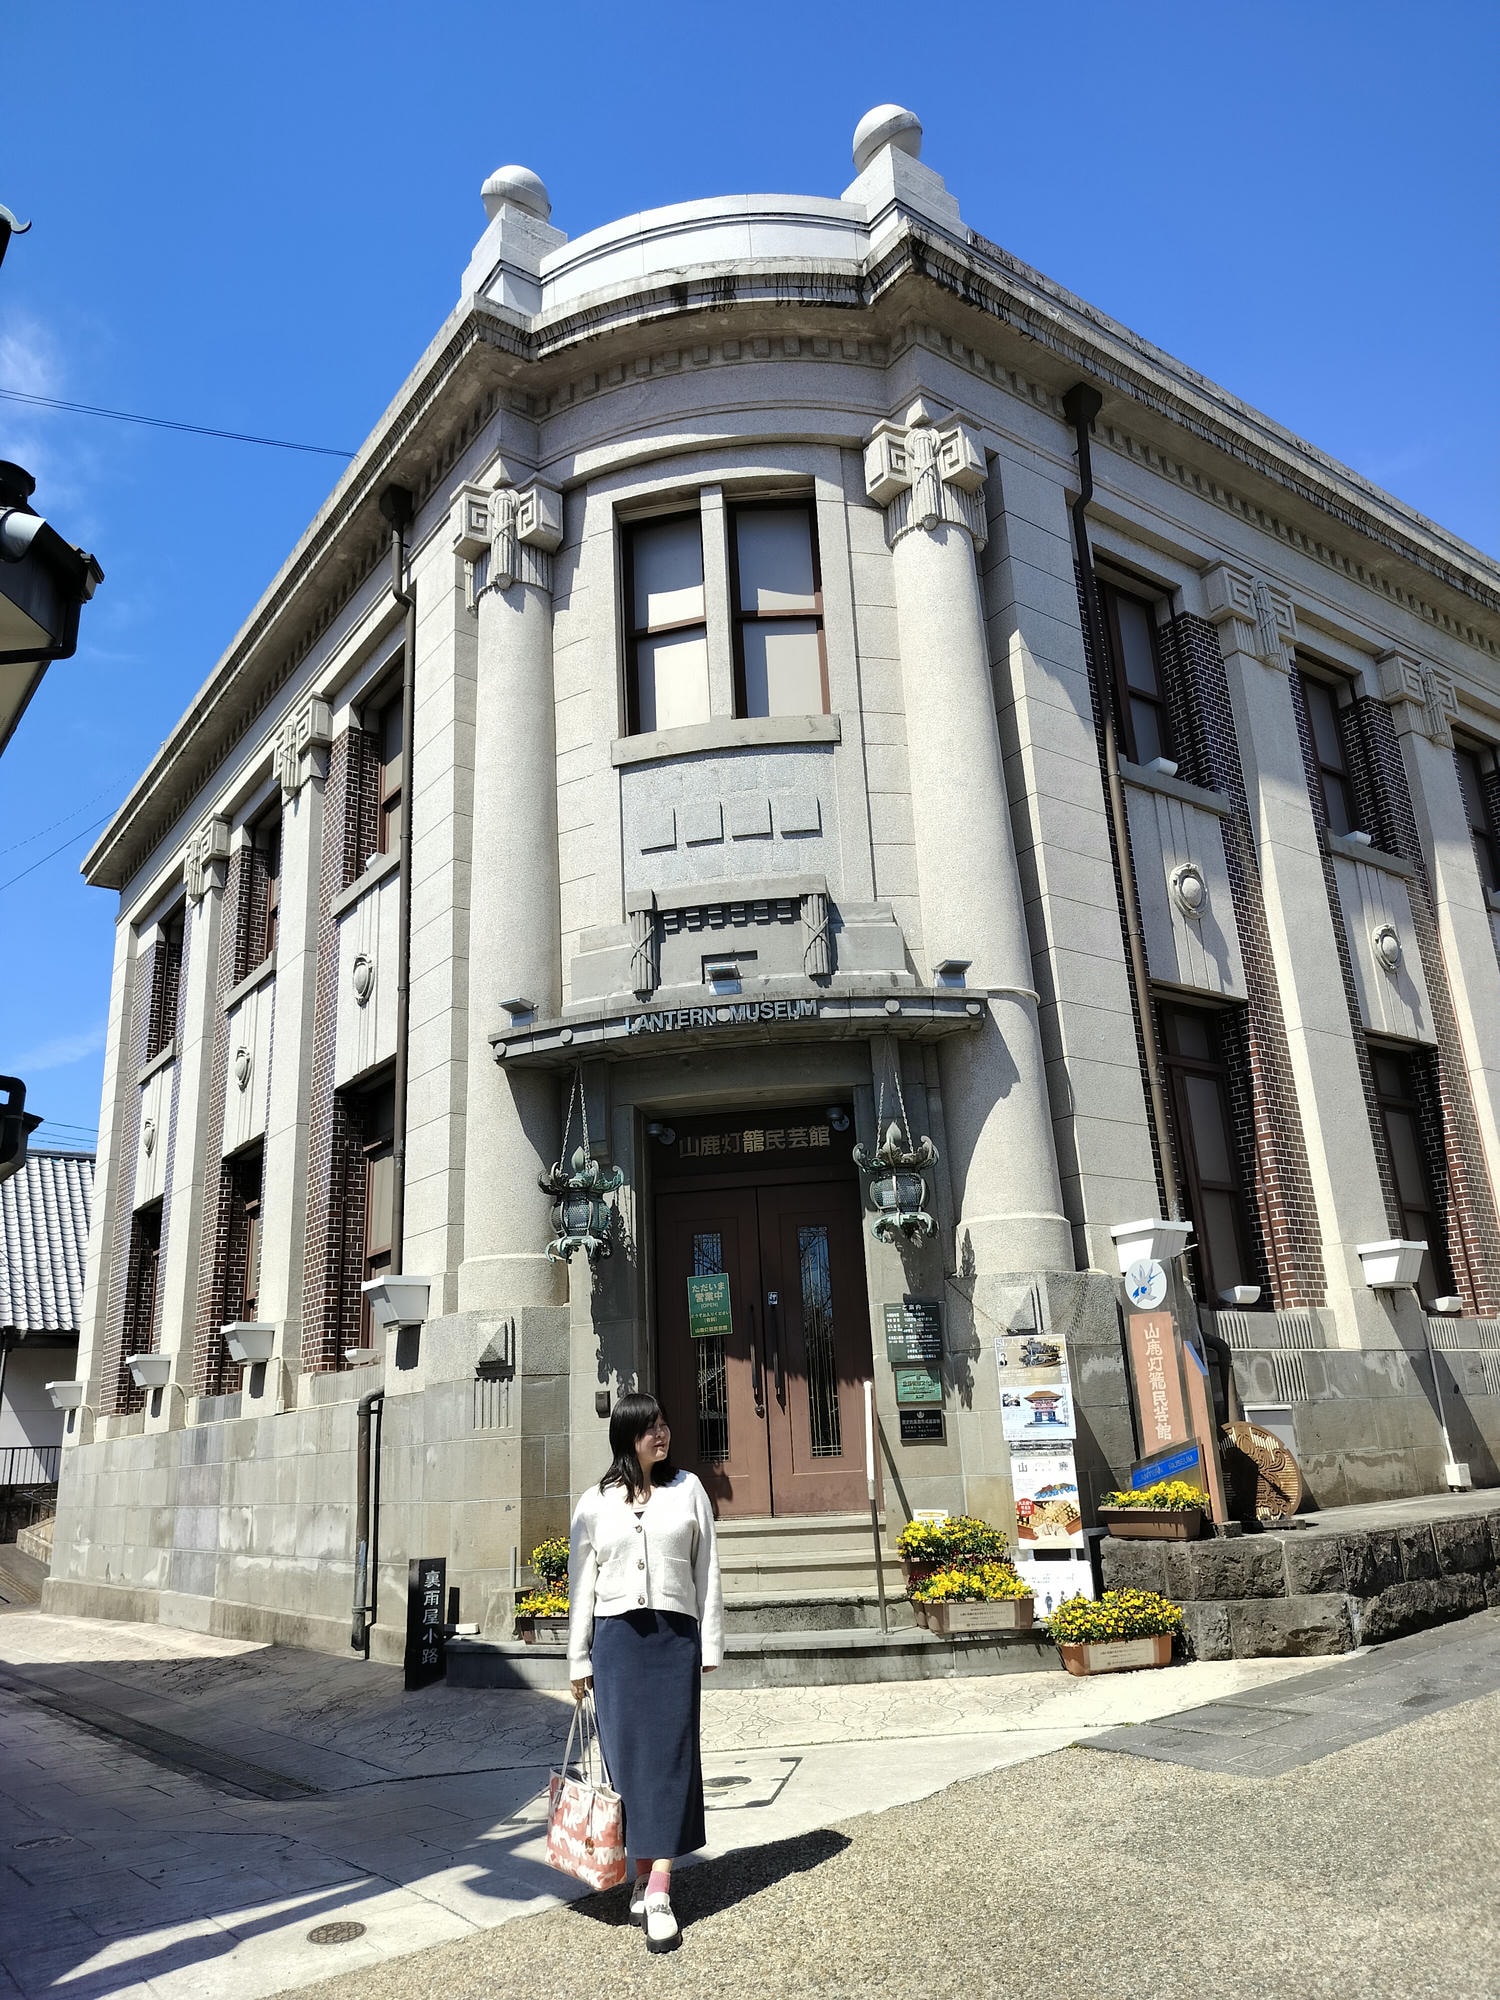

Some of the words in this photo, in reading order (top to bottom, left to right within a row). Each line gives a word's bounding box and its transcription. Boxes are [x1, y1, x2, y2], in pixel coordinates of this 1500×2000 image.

[625, 1006, 717, 1034] LANTERN
[729, 999, 818, 1023] MUSEUM
[679, 1125, 831, 1159] 山鹿灯籠民芸館
[691, 1281, 726, 1293] ただいま
[694, 1291, 723, 1303] 営業中
[1144, 1322, 1172, 1441] 山鹿灯籠民芸館
[422, 1570, 441, 1665] 裏雨屋小路
